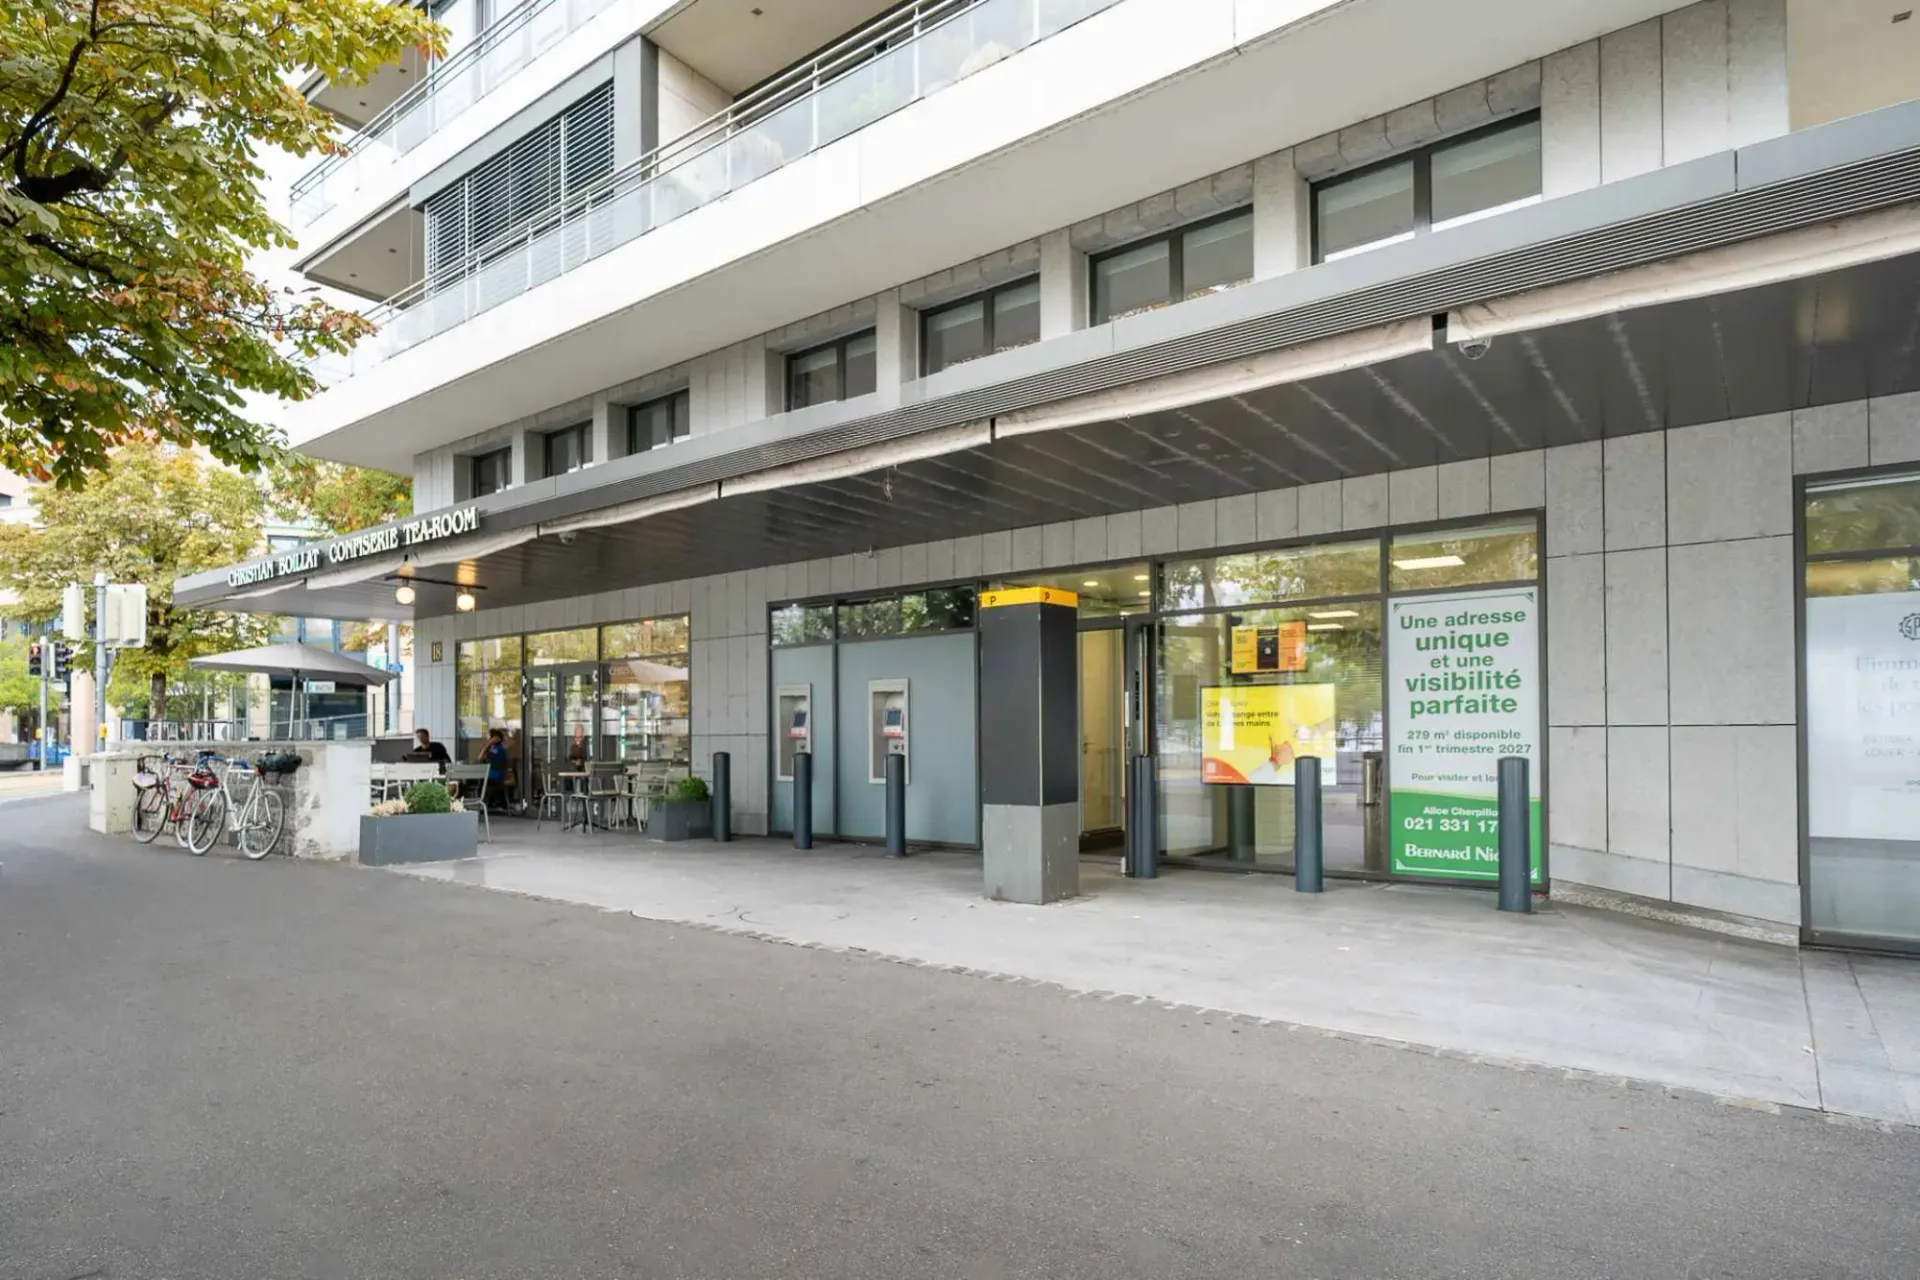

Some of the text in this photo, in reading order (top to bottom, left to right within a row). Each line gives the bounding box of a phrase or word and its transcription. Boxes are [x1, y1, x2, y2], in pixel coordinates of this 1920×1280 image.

[228, 507, 478, 587] CHRISTIAN BOILLAT CONFISERIE TEA-ROOM
[1400, 610, 1526, 629] Une adresse
[1415, 631, 1510, 652] unique
[432, 644, 442, 660] 18
[1430, 654, 1494, 668] et une
[1405, 668, 1522, 692] visibilité
[1410, 694, 1518, 719] parfaite
[1407, 730, 1430, 740] 279
[1454, 729, 1521, 741] disponible
[1398, 744, 1413, 753] fin
[1436, 744, 1494, 754] trimestre
[1498, 744, 1532, 754] 2027
[1411, 773, 1435, 781] Pour
[1437, 773, 1469, 781] visiter
[1471, 774, 1483, 782] et
[1423, 806, 1449, 815] Alice
[1404, 817, 1499, 833] 021 331 17
